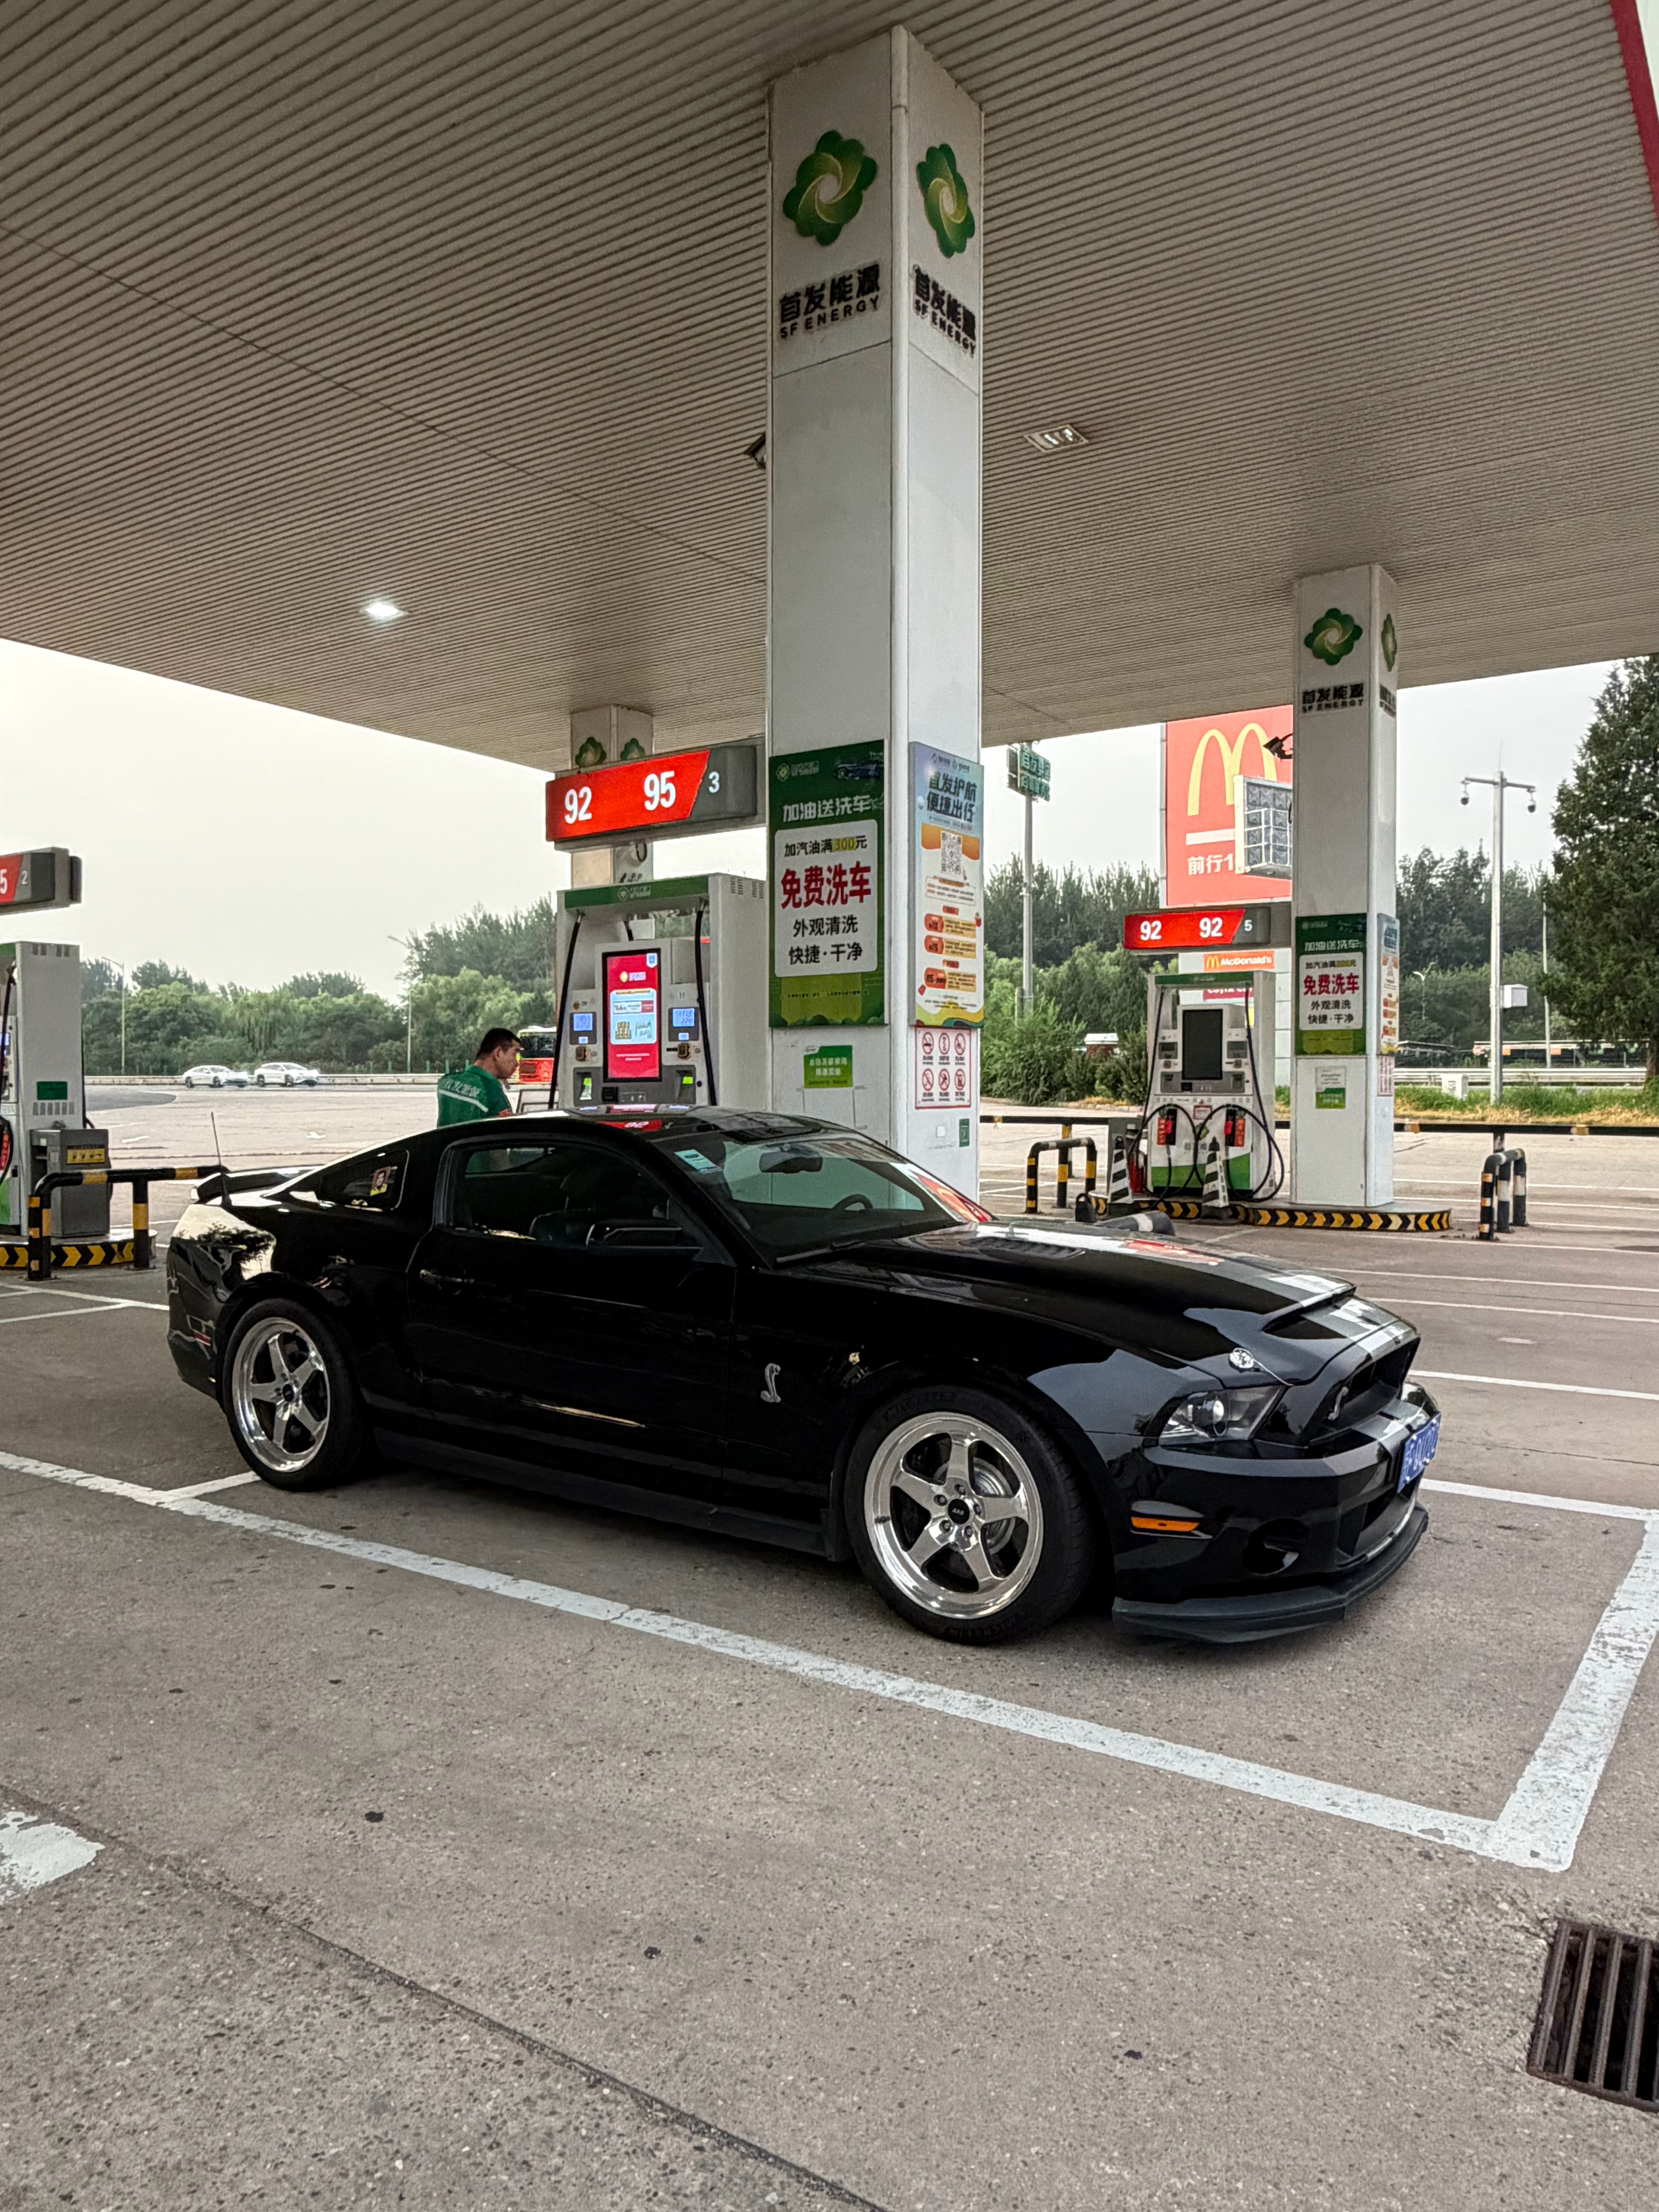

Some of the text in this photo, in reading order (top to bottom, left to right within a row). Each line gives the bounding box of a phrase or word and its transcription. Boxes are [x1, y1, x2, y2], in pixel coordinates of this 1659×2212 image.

[780, 263, 880, 324] 首发能源
[915, 268, 976, 341] 首发能源
[780, 295, 879, 338] SF ENERGY
[914, 299, 976, 358] SF ENERGY
[1302, 683, 1364, 704] 首发能源
[708, 771, 720, 793] 3
[564, 771, 676, 824] 92 95
[783, 795, 871, 823] 加油送洗车
[784, 835, 867, 857] 加汽油满300元
[21, 870, 28, 885] 2
[781, 860, 871, 909] 免费洗车
[793, 914, 859, 938] 外观清洗
[1140, 917, 1223, 941] 92 92
[1244, 919, 1253, 932] 5
[1305, 939, 1360, 951] 加油送洗车
[1221, 956, 1272, 967] McDonald's
[1303, 972, 1360, 996] 免费洗车
[1310, 1000, 1352, 1011] 外观清洗
